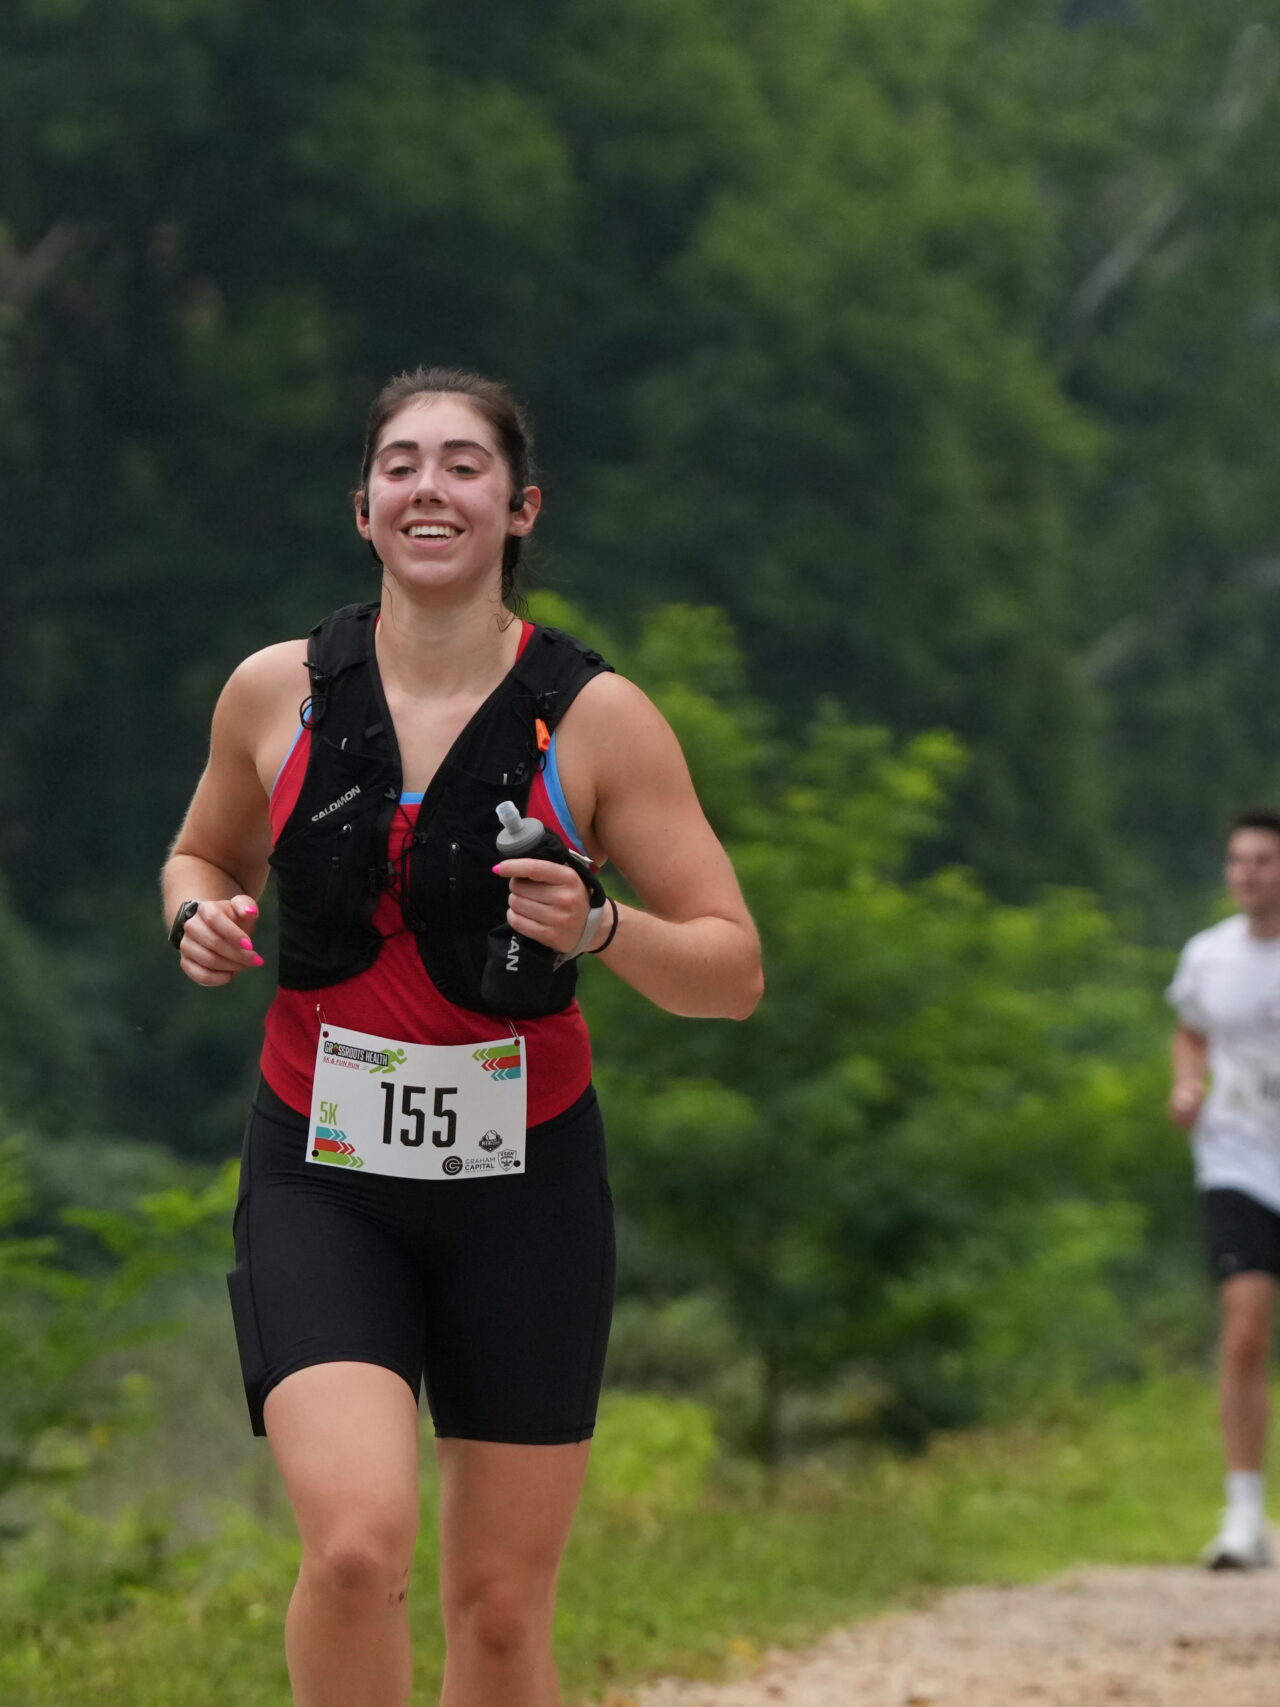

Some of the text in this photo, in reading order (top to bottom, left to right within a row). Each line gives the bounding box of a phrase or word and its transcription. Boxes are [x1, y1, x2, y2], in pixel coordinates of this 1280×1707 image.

[311, 785, 361, 822] SALOMON
[506, 936, 520, 971] AN
[365, 1050, 388, 1066] HEALTH
[320, 1101, 339, 1126] 5K
[380, 1081, 458, 1148] 155
[465, 1163, 495, 1171] CAPITAL
